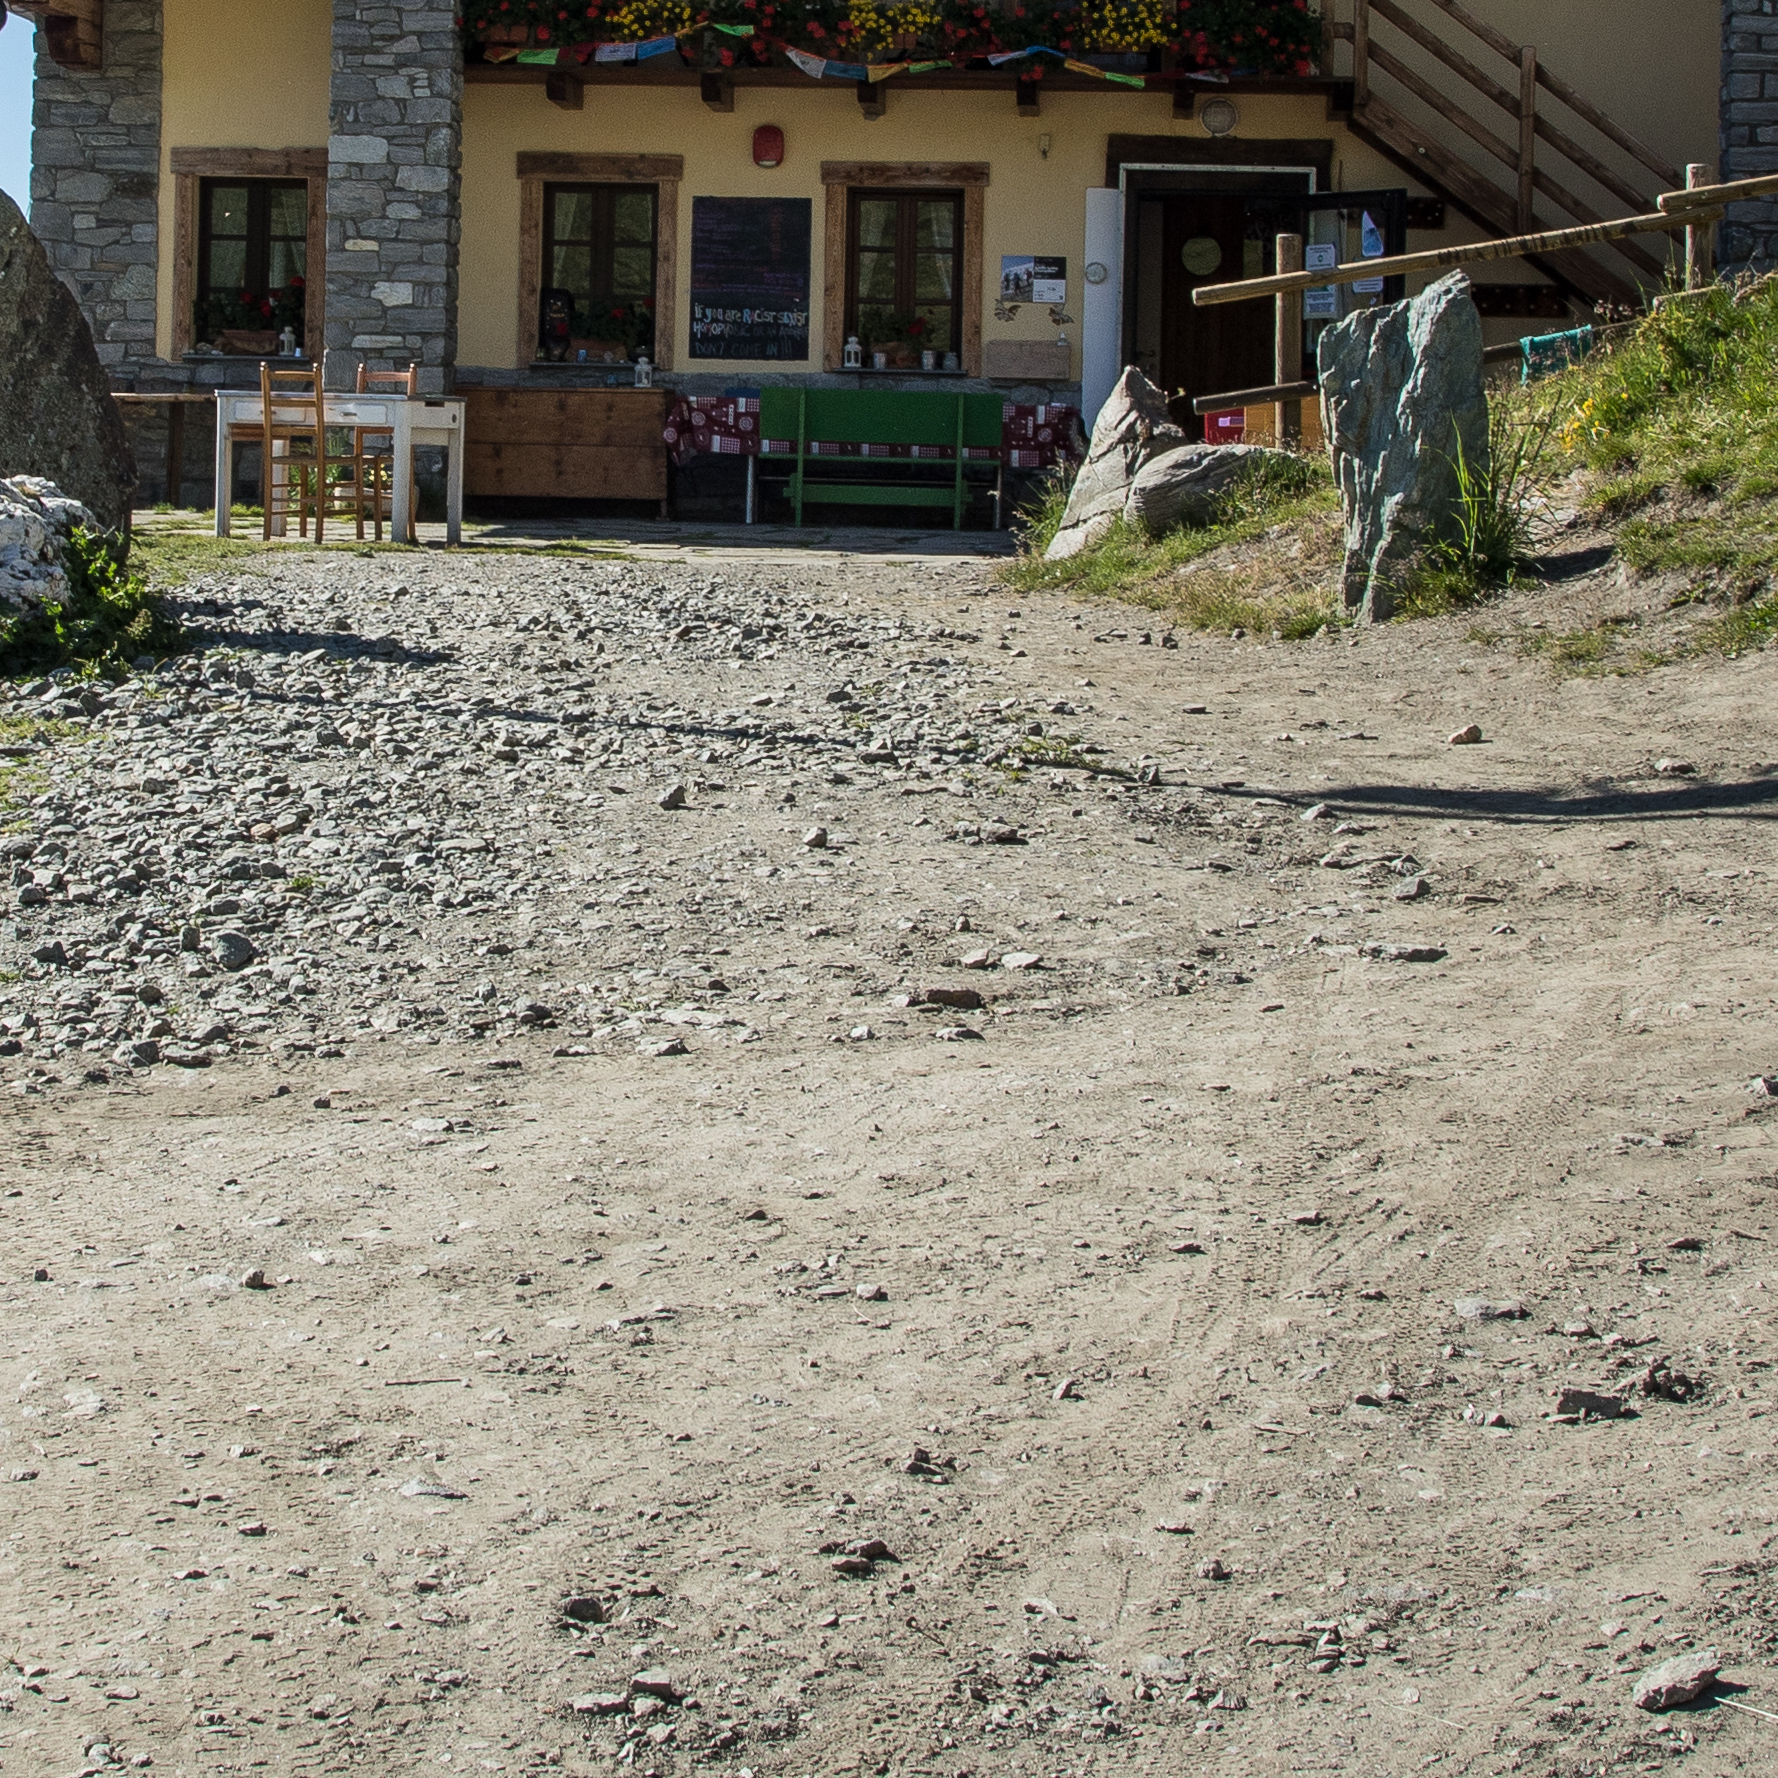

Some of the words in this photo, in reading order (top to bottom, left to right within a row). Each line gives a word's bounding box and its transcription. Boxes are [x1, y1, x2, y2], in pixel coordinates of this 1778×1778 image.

[703, 308, 723, 323] you
[724, 309, 742, 322] are
[766, 342, 778, 356] IN
